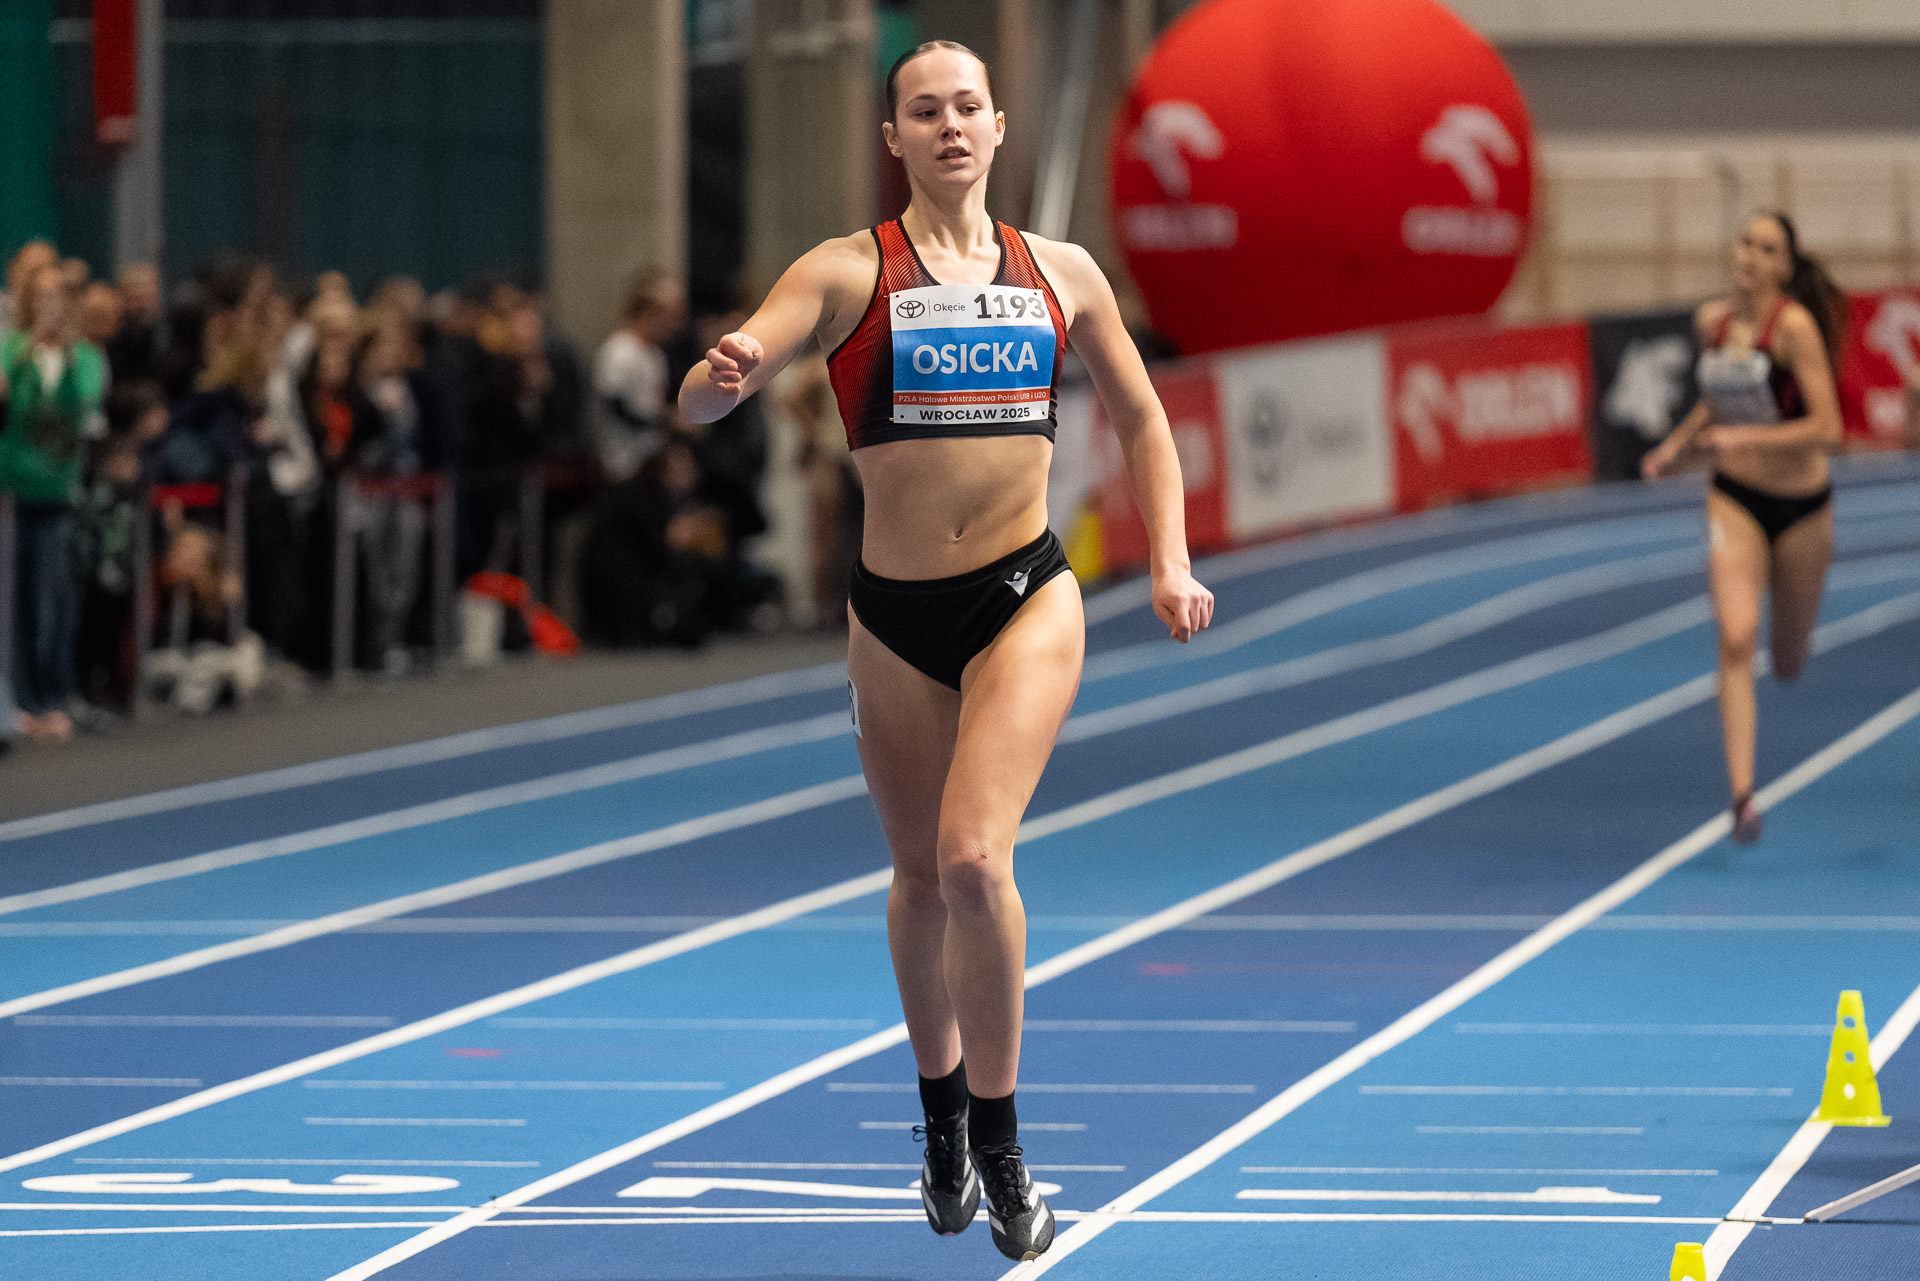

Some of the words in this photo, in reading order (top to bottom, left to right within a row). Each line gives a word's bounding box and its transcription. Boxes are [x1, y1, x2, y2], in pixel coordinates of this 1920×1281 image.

[932, 302, 966, 312] Okęcie
[974, 293, 1046, 319] 1193
[912, 341, 1038, 375] OSICKA
[919, 395, 947, 403] Halowe
[949, 395, 996, 403] Mistrzostwa
[997, 393, 1018, 401] Polski
[1020, 392, 1030, 400] U18
[1034, 391, 1047, 399] U20
[919, 409, 997, 420] WROCŁAW
[1000, 407, 1030, 419] 2025
[21, 1173, 460, 1194] 3
